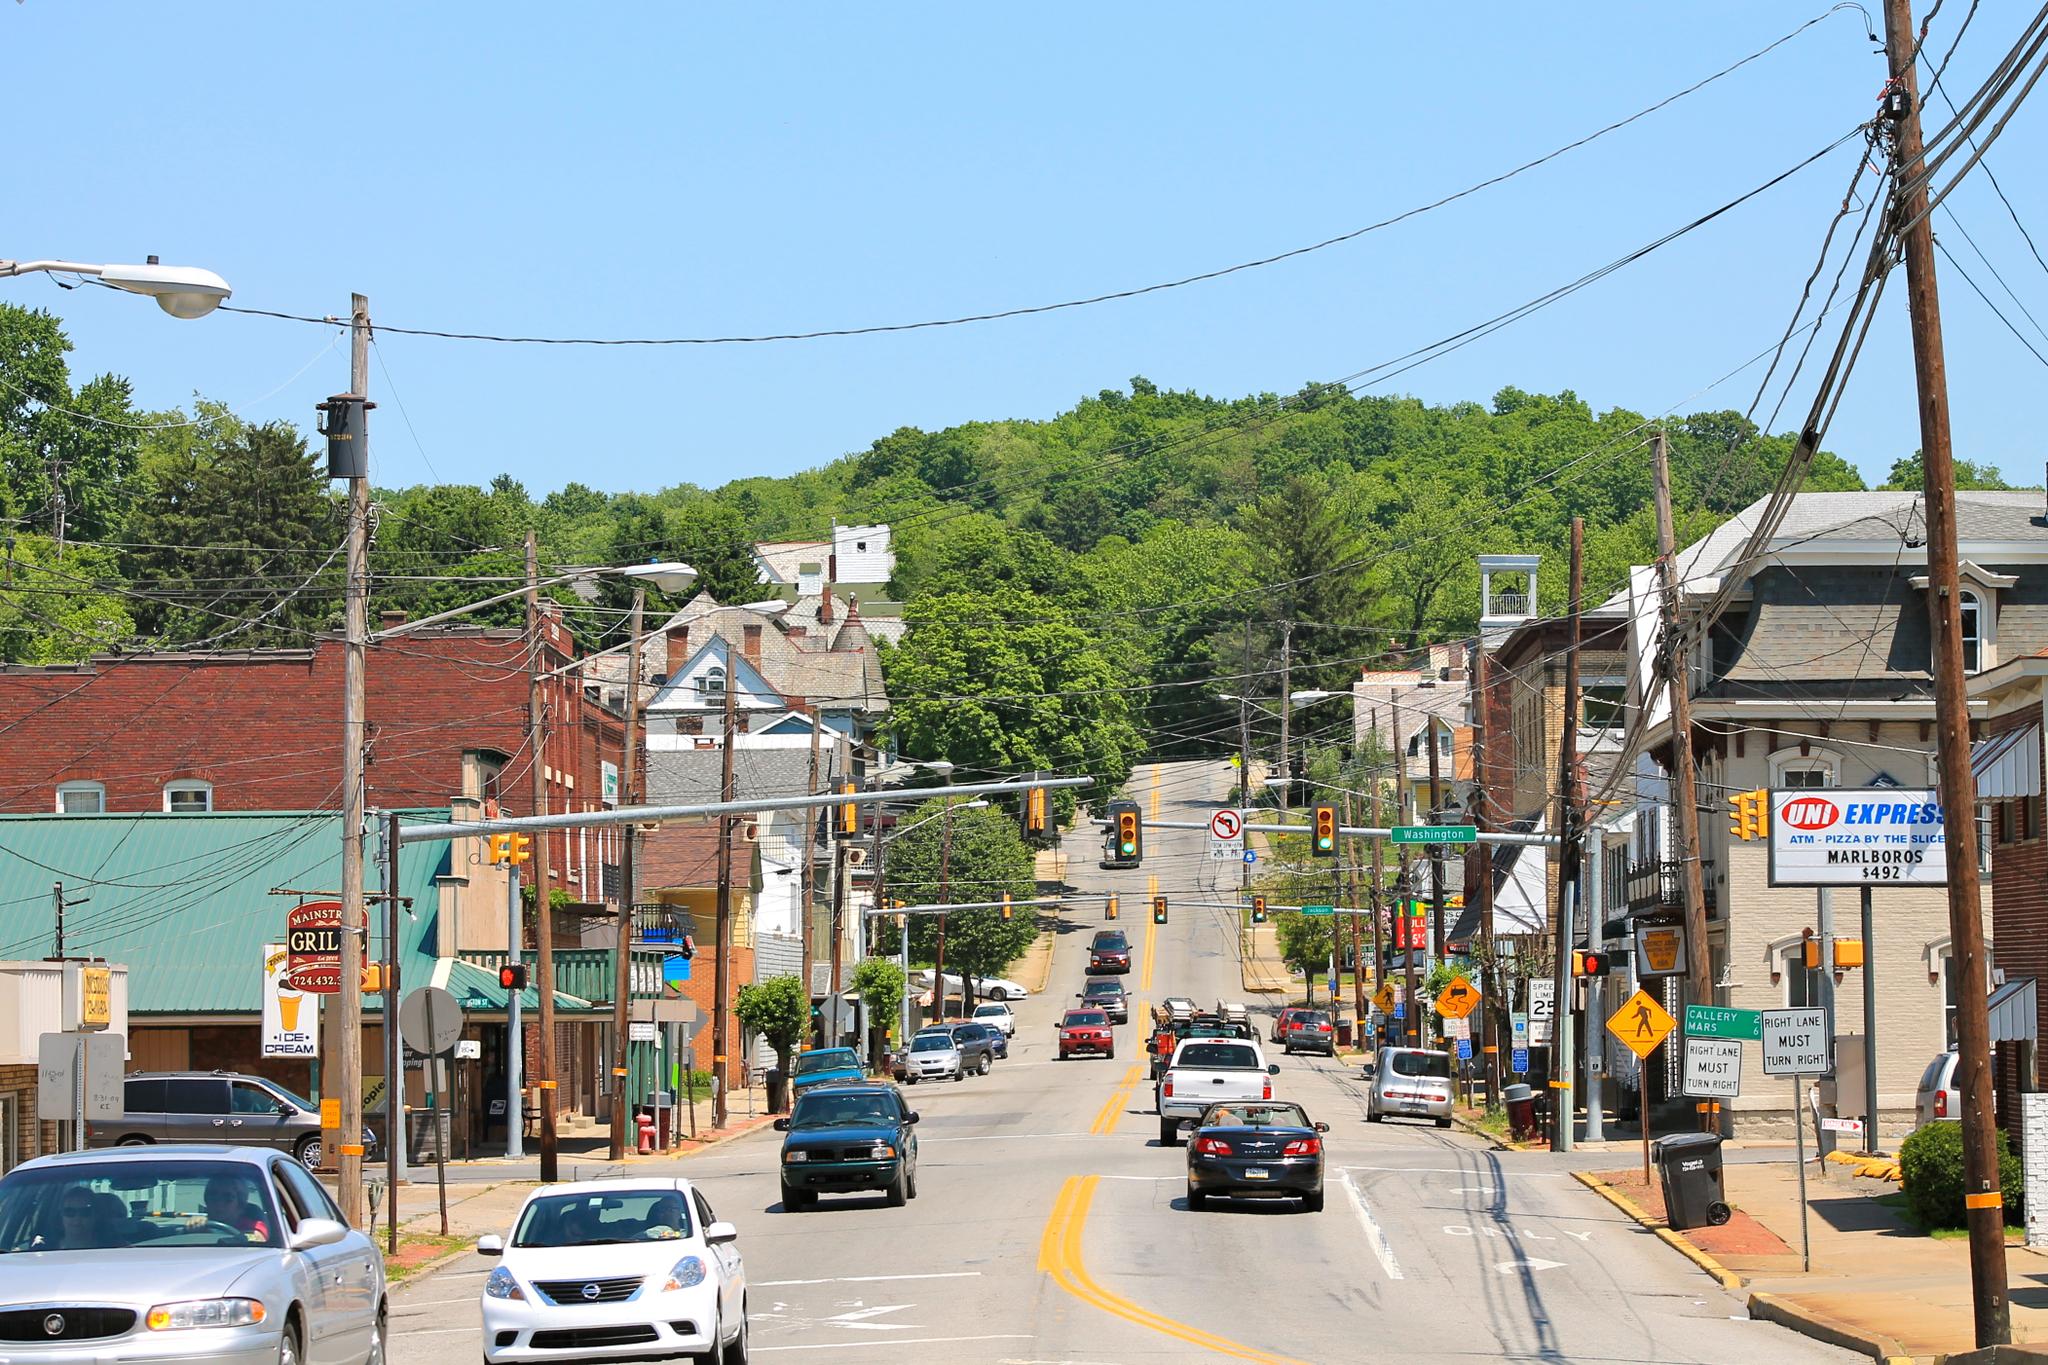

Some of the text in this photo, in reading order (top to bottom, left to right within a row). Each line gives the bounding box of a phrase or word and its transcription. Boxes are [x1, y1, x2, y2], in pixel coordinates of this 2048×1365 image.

[1787, 803, 1833, 825] UNI
[1403, 829, 1464, 841] Washington
[1790, 835, 1814, 844] ATM
[1825, 834, 1860, 844] PIZZA
[1864, 834, 1879, 844] BY
[1885, 834, 1907, 844] THE
[1911, 834, 1945, 843] SLICE
[1828, 850, 1923, 863] MARLBOROS
[1863, 866, 1900, 879] $492
[1534, 1000, 1554, 1015] 25
[1689, 1009, 1760, 1024] CALLERY 2
[1765, 1016, 1821, 1029] RIGHT LANE
[1688, 1021, 1759, 1036] MARS 6
[278, 1033, 304, 1042] ICE
[1778, 1034, 1811, 1048] MUST
[265, 1044, 314, 1054] CREAM
[1690, 1046, 1739, 1058] RIGHT LANE
[1766, 1053, 1825, 1067] TURN RIGHT
[1698, 1062, 1729, 1074] MUST
[1688, 1078, 1737, 1090] TURN RIGHT
[1443, 1225, 1592, 1241] ONLY
